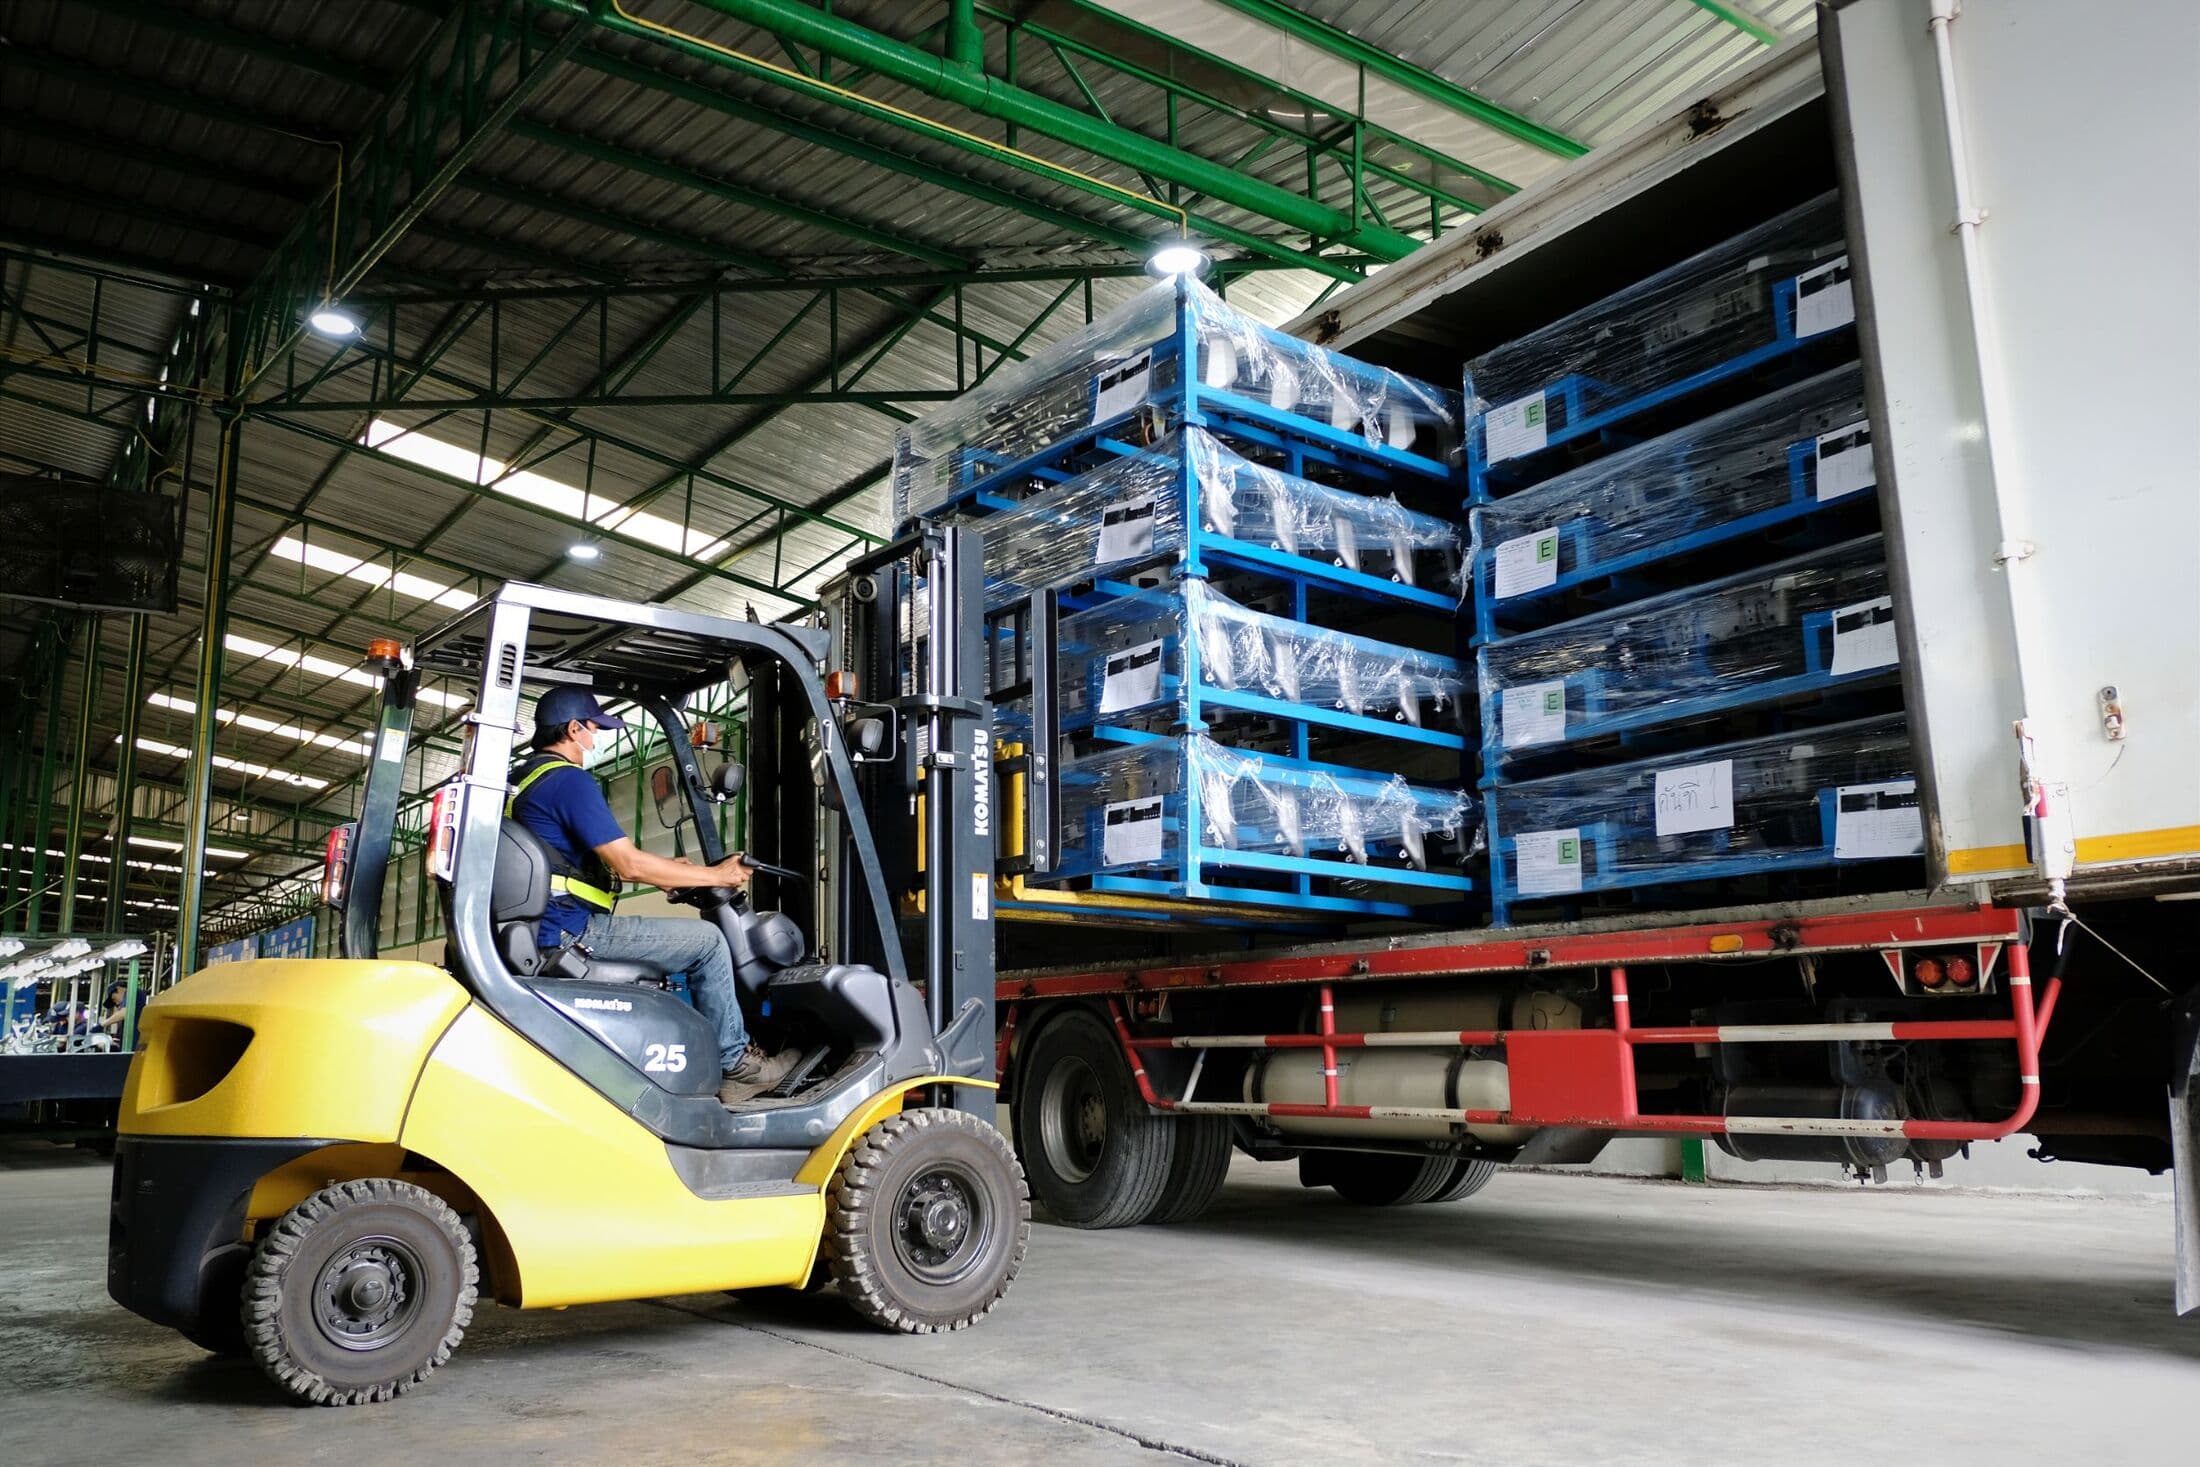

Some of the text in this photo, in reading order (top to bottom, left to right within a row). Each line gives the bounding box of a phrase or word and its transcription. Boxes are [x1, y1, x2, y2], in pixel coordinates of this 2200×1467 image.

[1528, 404, 1539, 422] E
[1541, 540, 1551, 558] E
[1547, 693, 1558, 710] E
[971, 729, 989, 836] KOMATSU
[1562, 841, 1573, 859] E
[644, 1044, 687, 1073] 25
